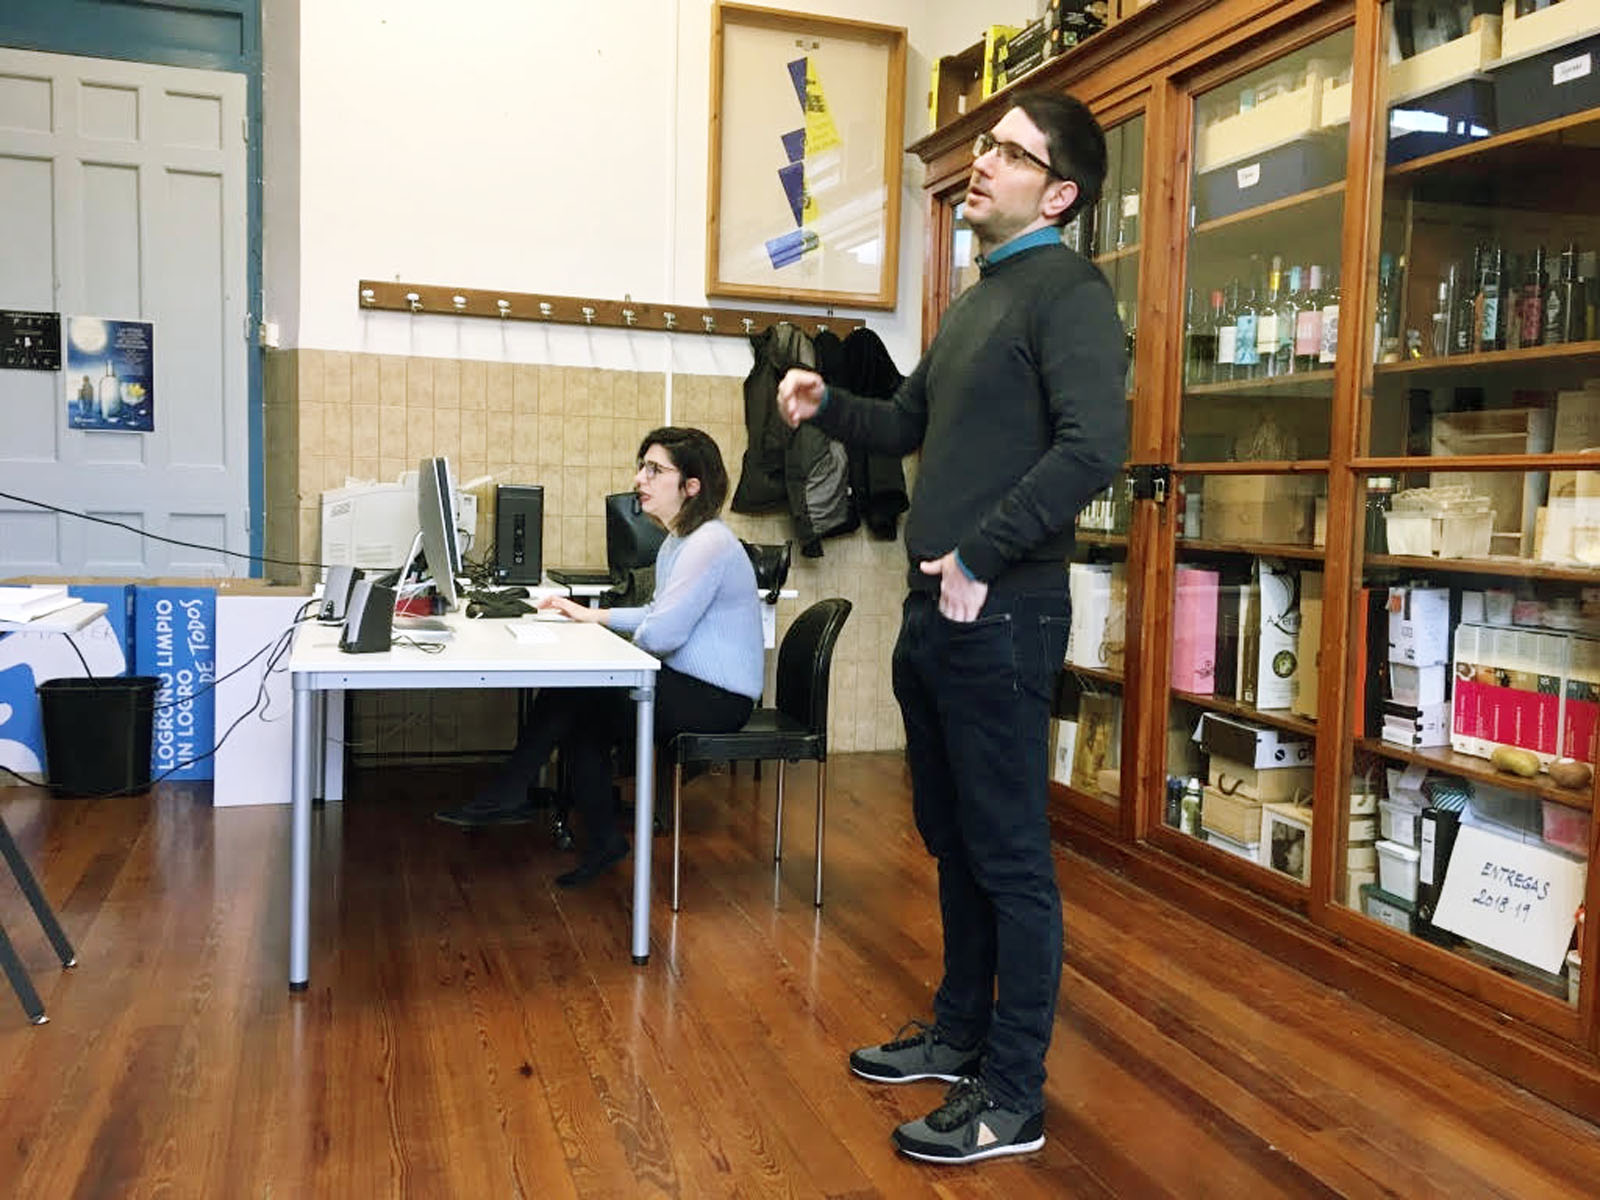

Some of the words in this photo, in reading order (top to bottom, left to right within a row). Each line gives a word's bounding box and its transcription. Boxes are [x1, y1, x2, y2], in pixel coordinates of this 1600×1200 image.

[156, 599, 173, 667] LIMPIO
[179, 599, 211, 657] TODOS
[194, 660, 215, 683] DE
[176, 669, 194, 737] LOGRO
[1481, 862, 1550, 900] ENTREGAS
